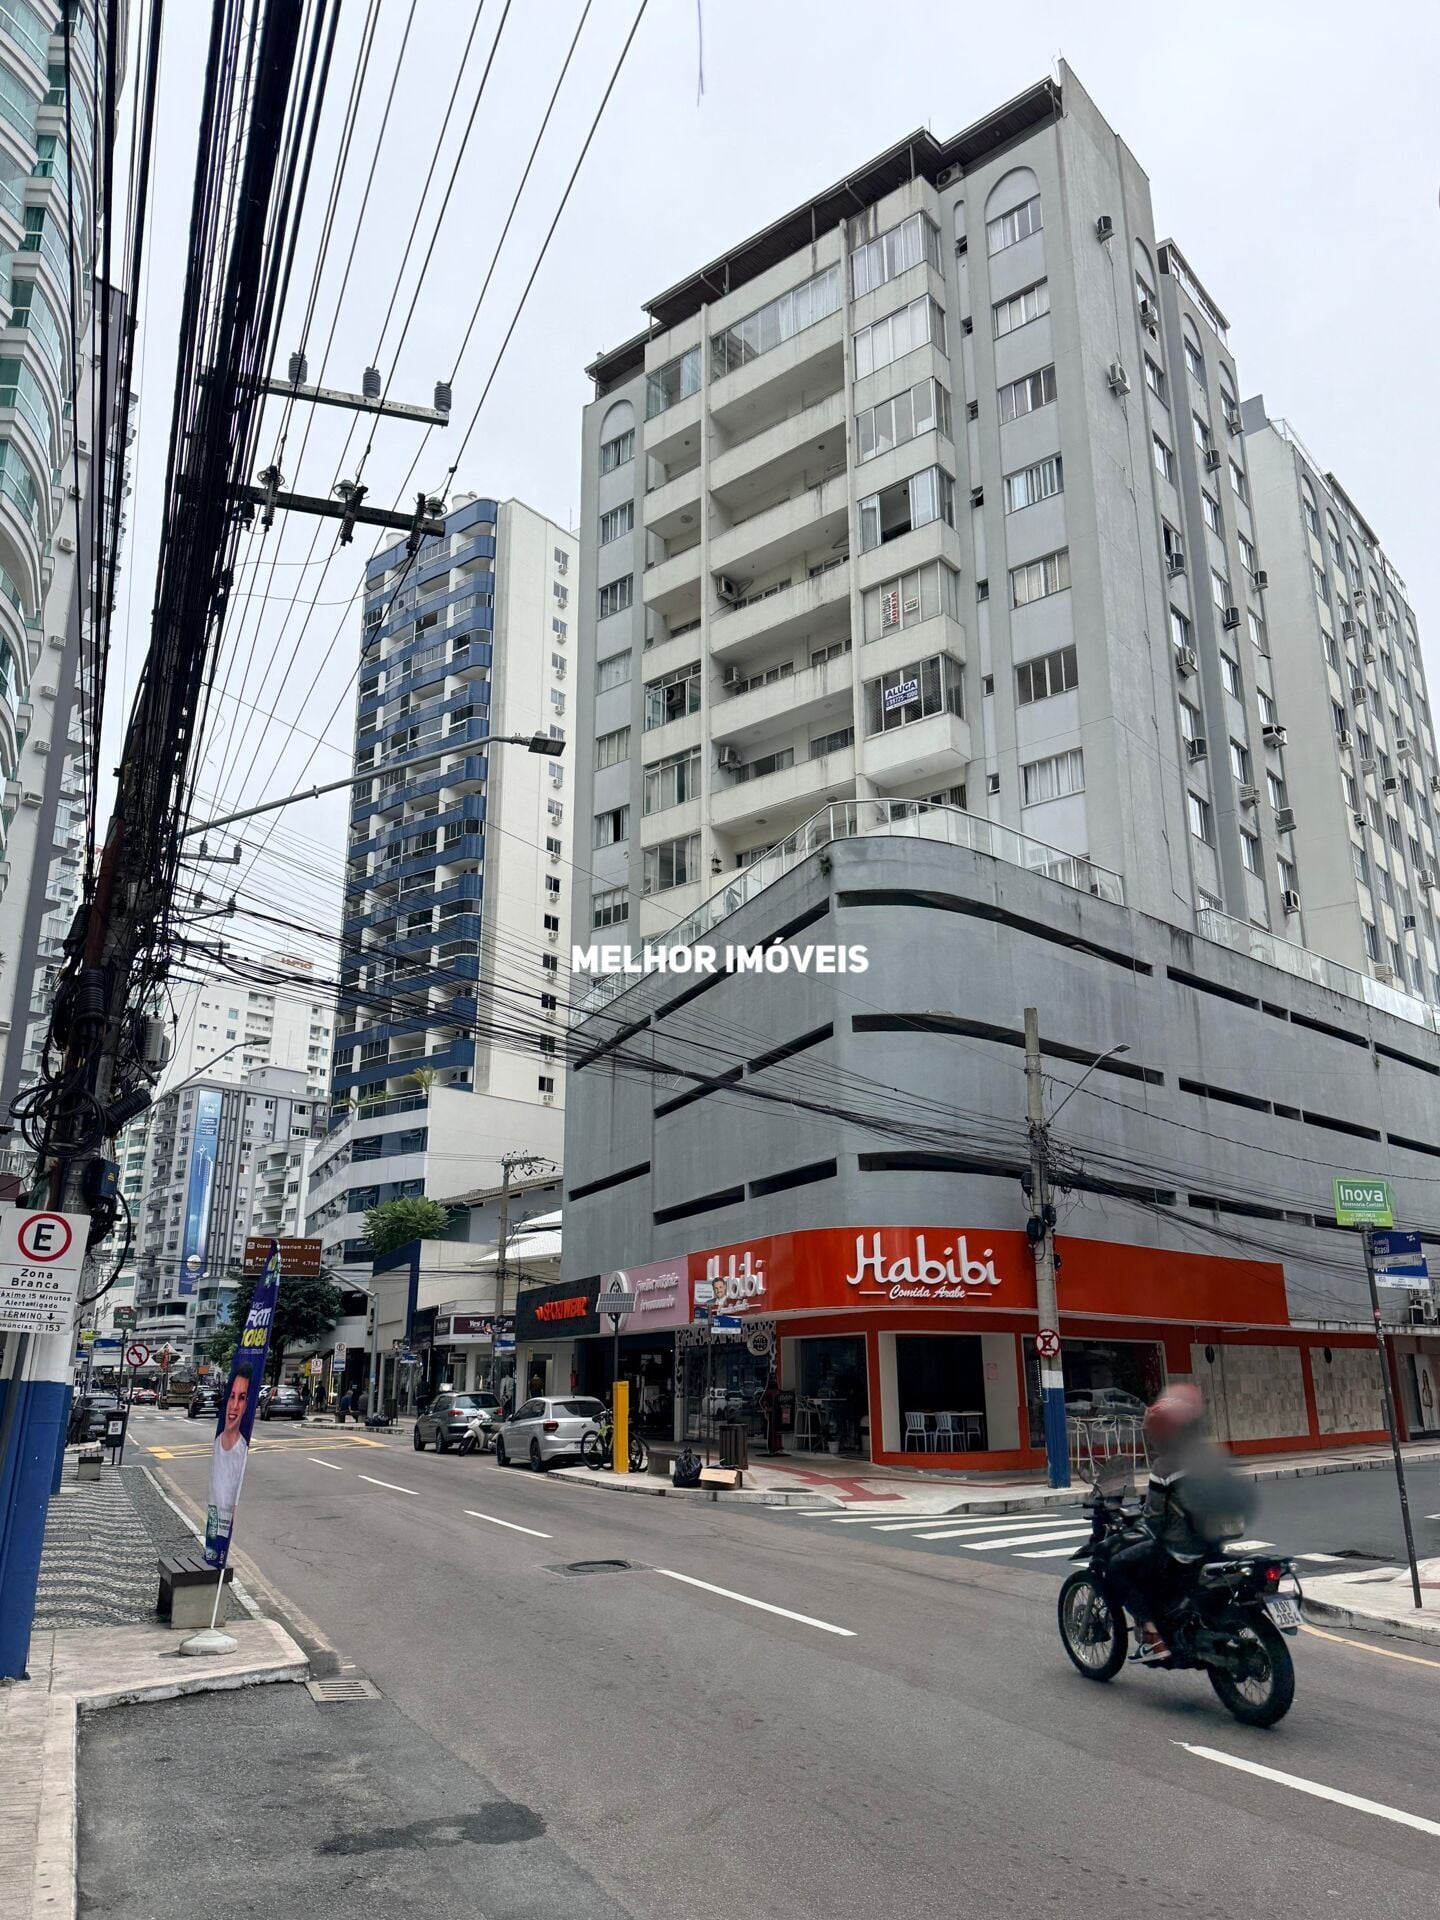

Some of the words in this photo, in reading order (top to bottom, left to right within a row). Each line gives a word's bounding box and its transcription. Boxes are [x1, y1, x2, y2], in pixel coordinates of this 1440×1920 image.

[887, 681, 916, 698] ALUGA
[1340, 1185, 1384, 1202] Inova
[33, 1223, 55, 1251] E
[1374, 1244, 1390, 1254] Brasil
[846, 1231, 1002, 1285] Habibi
[20, 1268, 53, 1279] Zona
[11, 1277, 60, 1290] Branca
[0, 1291, 26, 1300] áximo
[28, 1292, 37, 1300] 15
[39, 1293, 71, 1302] Minutos
[889, 1284, 931, 1300] Comida
[932, 1281, 966, 1299] Árabe
[5, 1299, 30, 1307] Alerta
[32, 1301, 58, 1309] ligado
[45, 1324, 60, 1332] 153
